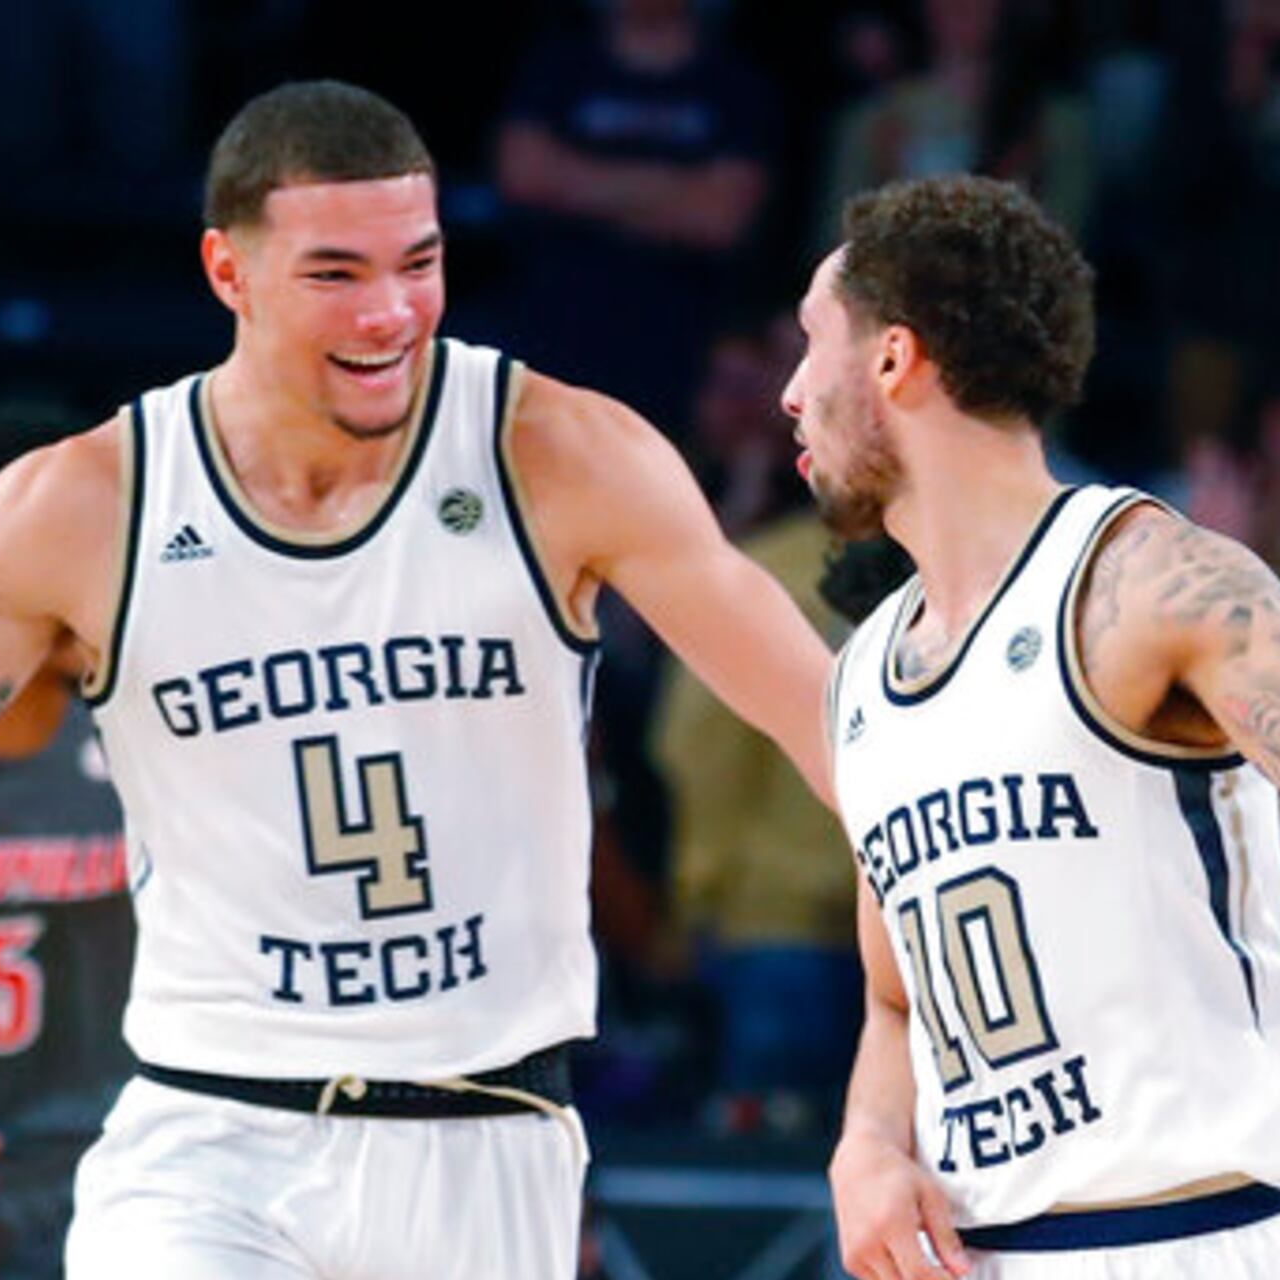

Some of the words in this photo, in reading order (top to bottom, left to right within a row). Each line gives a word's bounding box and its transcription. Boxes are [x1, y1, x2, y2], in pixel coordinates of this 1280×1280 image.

[153, 635, 525, 737] GEORGIA
[292, 733, 434, 921] 4
[857, 773, 1099, 907] EORGIA
[258, 914, 488, 1007] TECH
[898, 864, 1061, 1095] 10
[938, 1055, 1103, 1173] TECH
